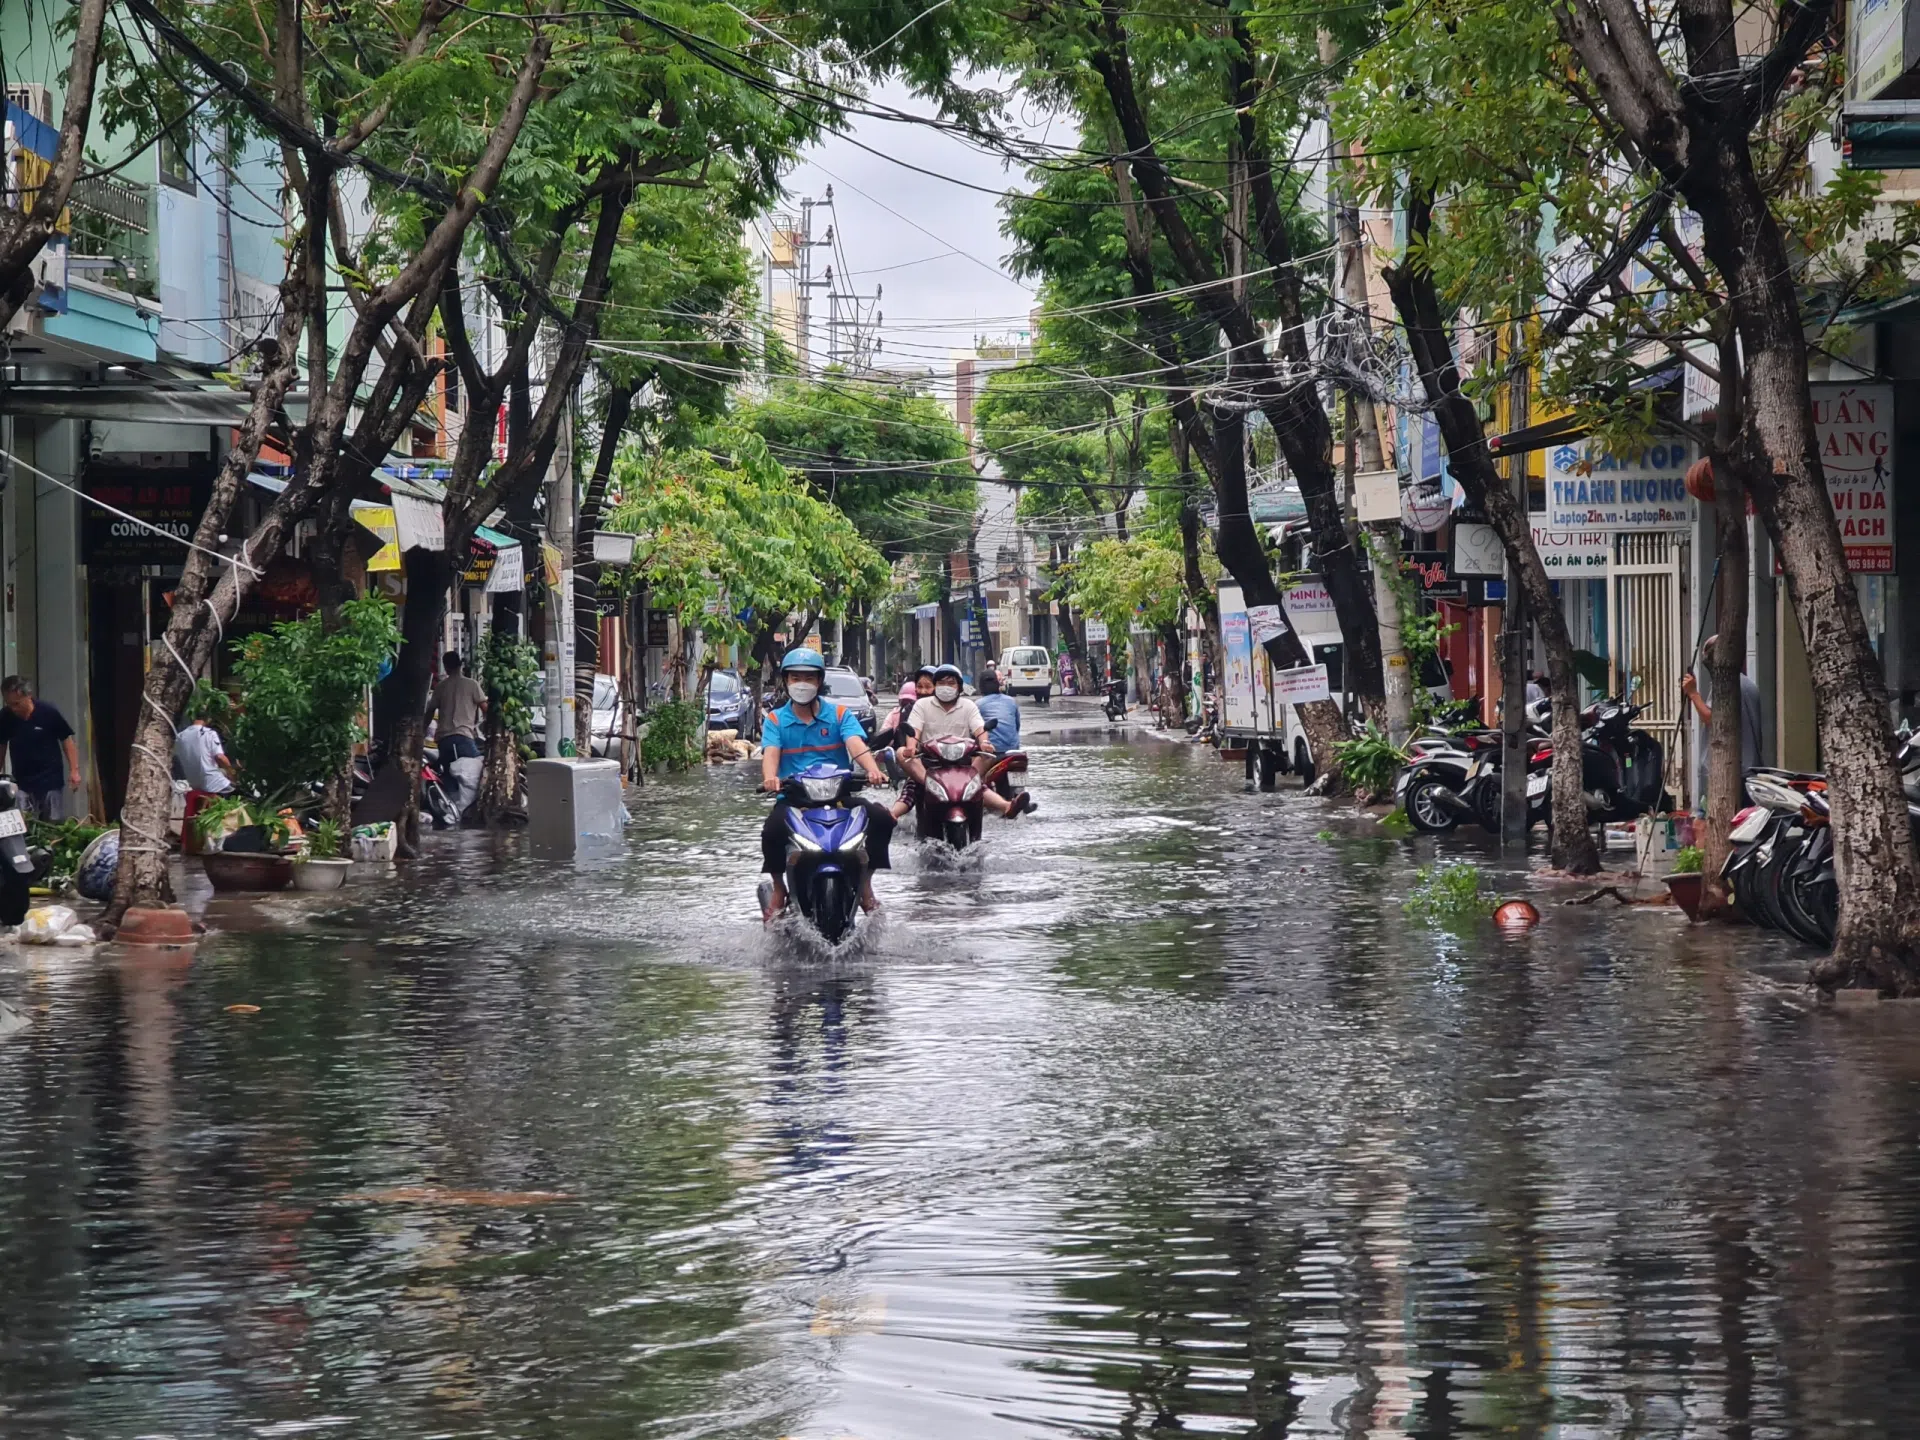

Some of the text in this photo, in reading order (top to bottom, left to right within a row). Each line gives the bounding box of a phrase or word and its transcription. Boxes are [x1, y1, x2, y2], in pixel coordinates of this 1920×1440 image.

[1812, 388, 1876, 425] UẤN
[1822, 431, 1889, 456] ANG
[1553, 480, 1616, 505] THANH
[1833, 488, 1886, 510] VÍ DA
[1553, 508, 1686, 525] LaptopZin.vn LaptopRe.vn
[1837, 515, 1885, 536] ÁCH
[110, 519, 151, 537] CÔNG
[1544, 553, 1562, 566] GÓI
[1290, 589, 1316, 601] MINI
